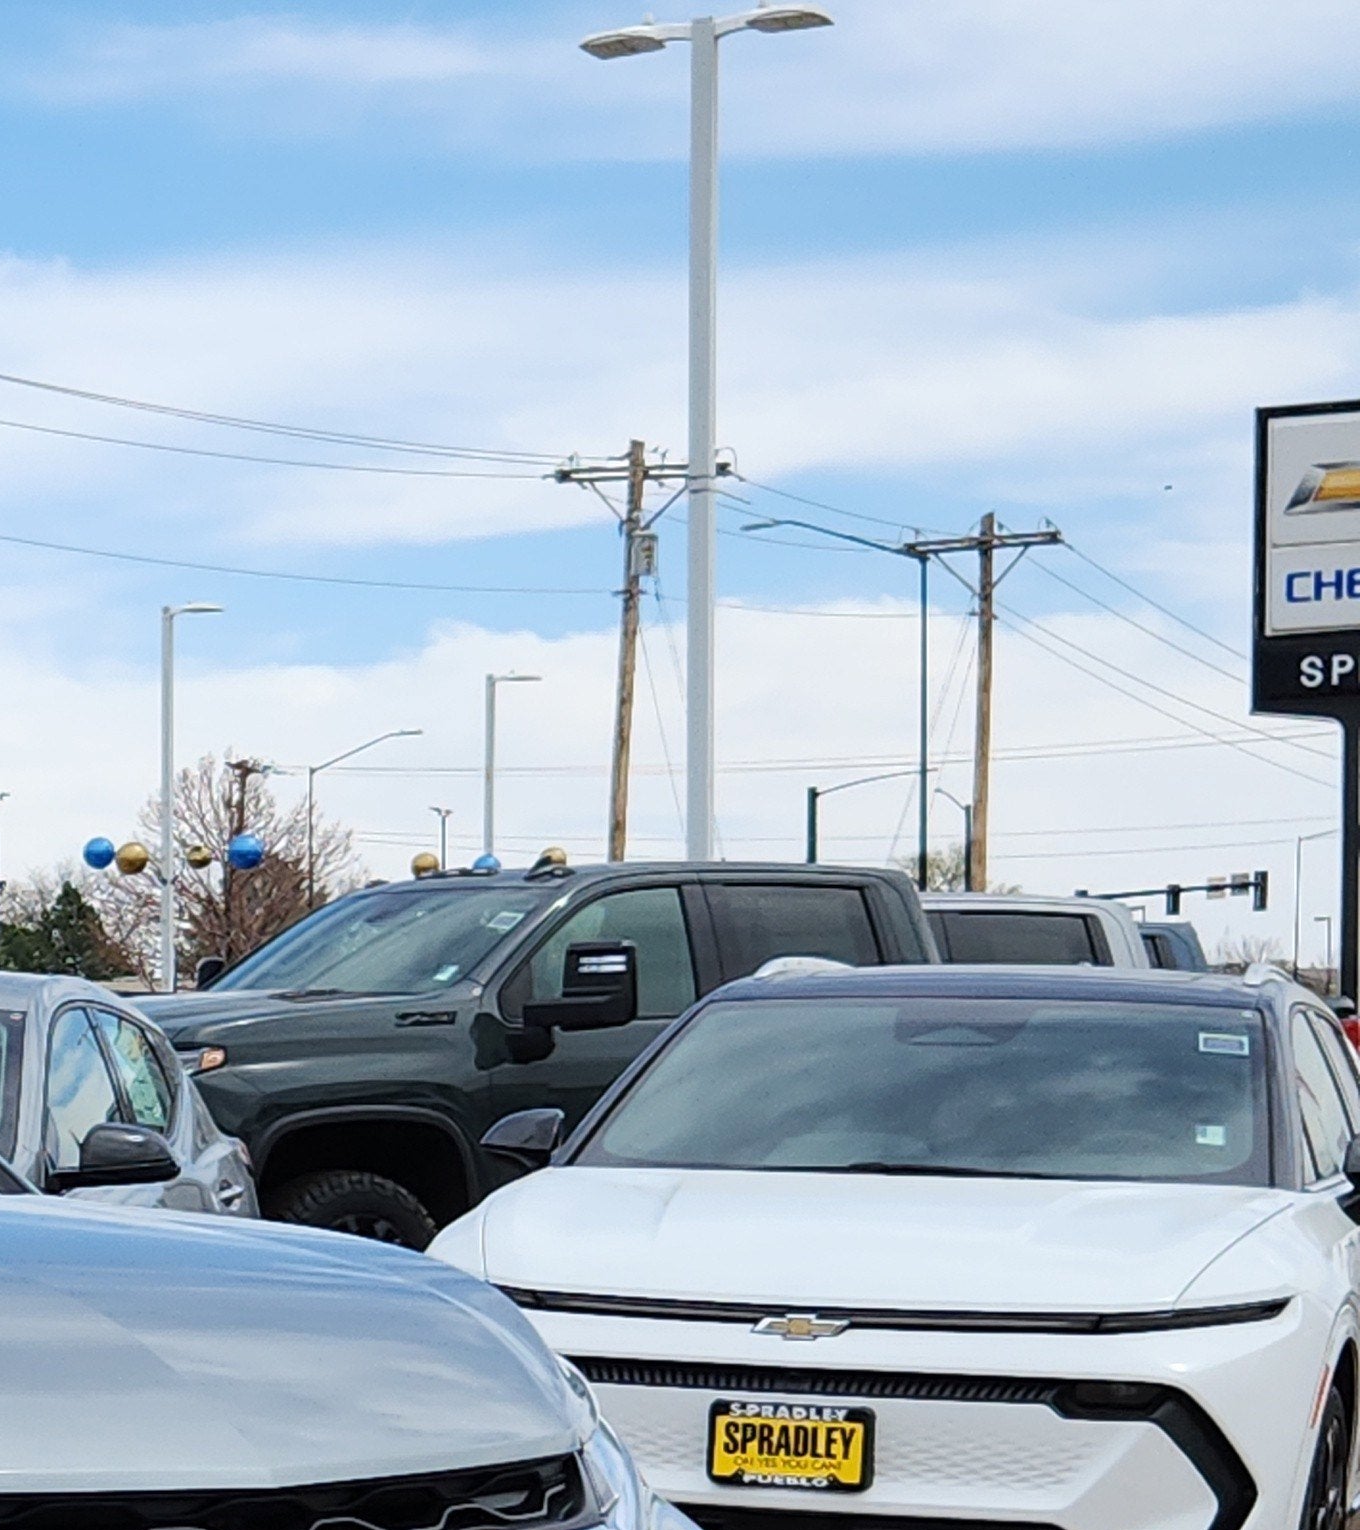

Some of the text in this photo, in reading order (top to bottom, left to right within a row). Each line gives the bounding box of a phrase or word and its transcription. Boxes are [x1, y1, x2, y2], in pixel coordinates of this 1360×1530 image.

[729, 1402, 849, 1421] SPRADLEY
[723, 1421, 857, 1460] SPRADLEY
[781, 1458, 807, 1470] YOU
[743, 1473, 828, 1488] PUEBLO
